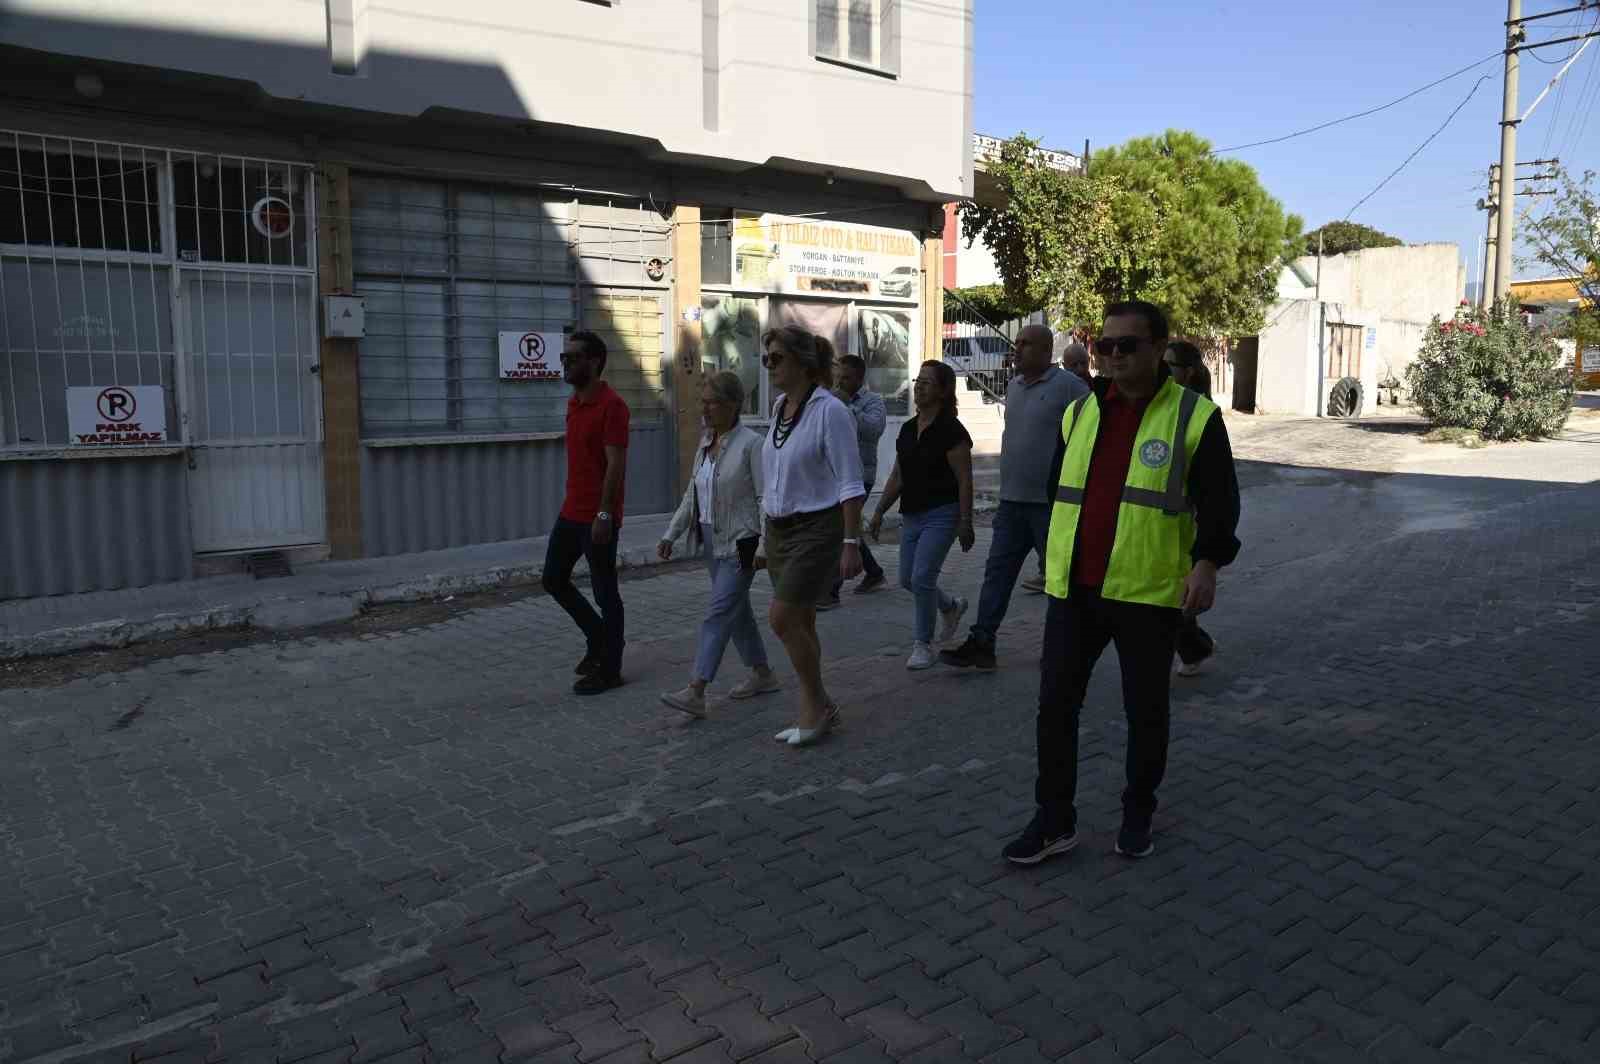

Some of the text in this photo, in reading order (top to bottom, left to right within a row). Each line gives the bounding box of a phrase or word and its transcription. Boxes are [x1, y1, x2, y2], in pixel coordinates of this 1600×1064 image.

[786, 223, 819, 245] YILDIZ
[822, 227, 844, 248] OTO
[857, 231, 878, 251] HALI
[880, 233, 915, 256] YIKAMA
[802, 251, 828, 262] YORGAN
[789, 264, 806, 273] STOR
[807, 266, 827, 275] PERDE
[517, 362, 549, 370] PARK
[504, 370, 561, 378] YAPILMAZ
[95, 422, 143, 433] PARK
[77, 432, 161, 443] YAPILMAZ
